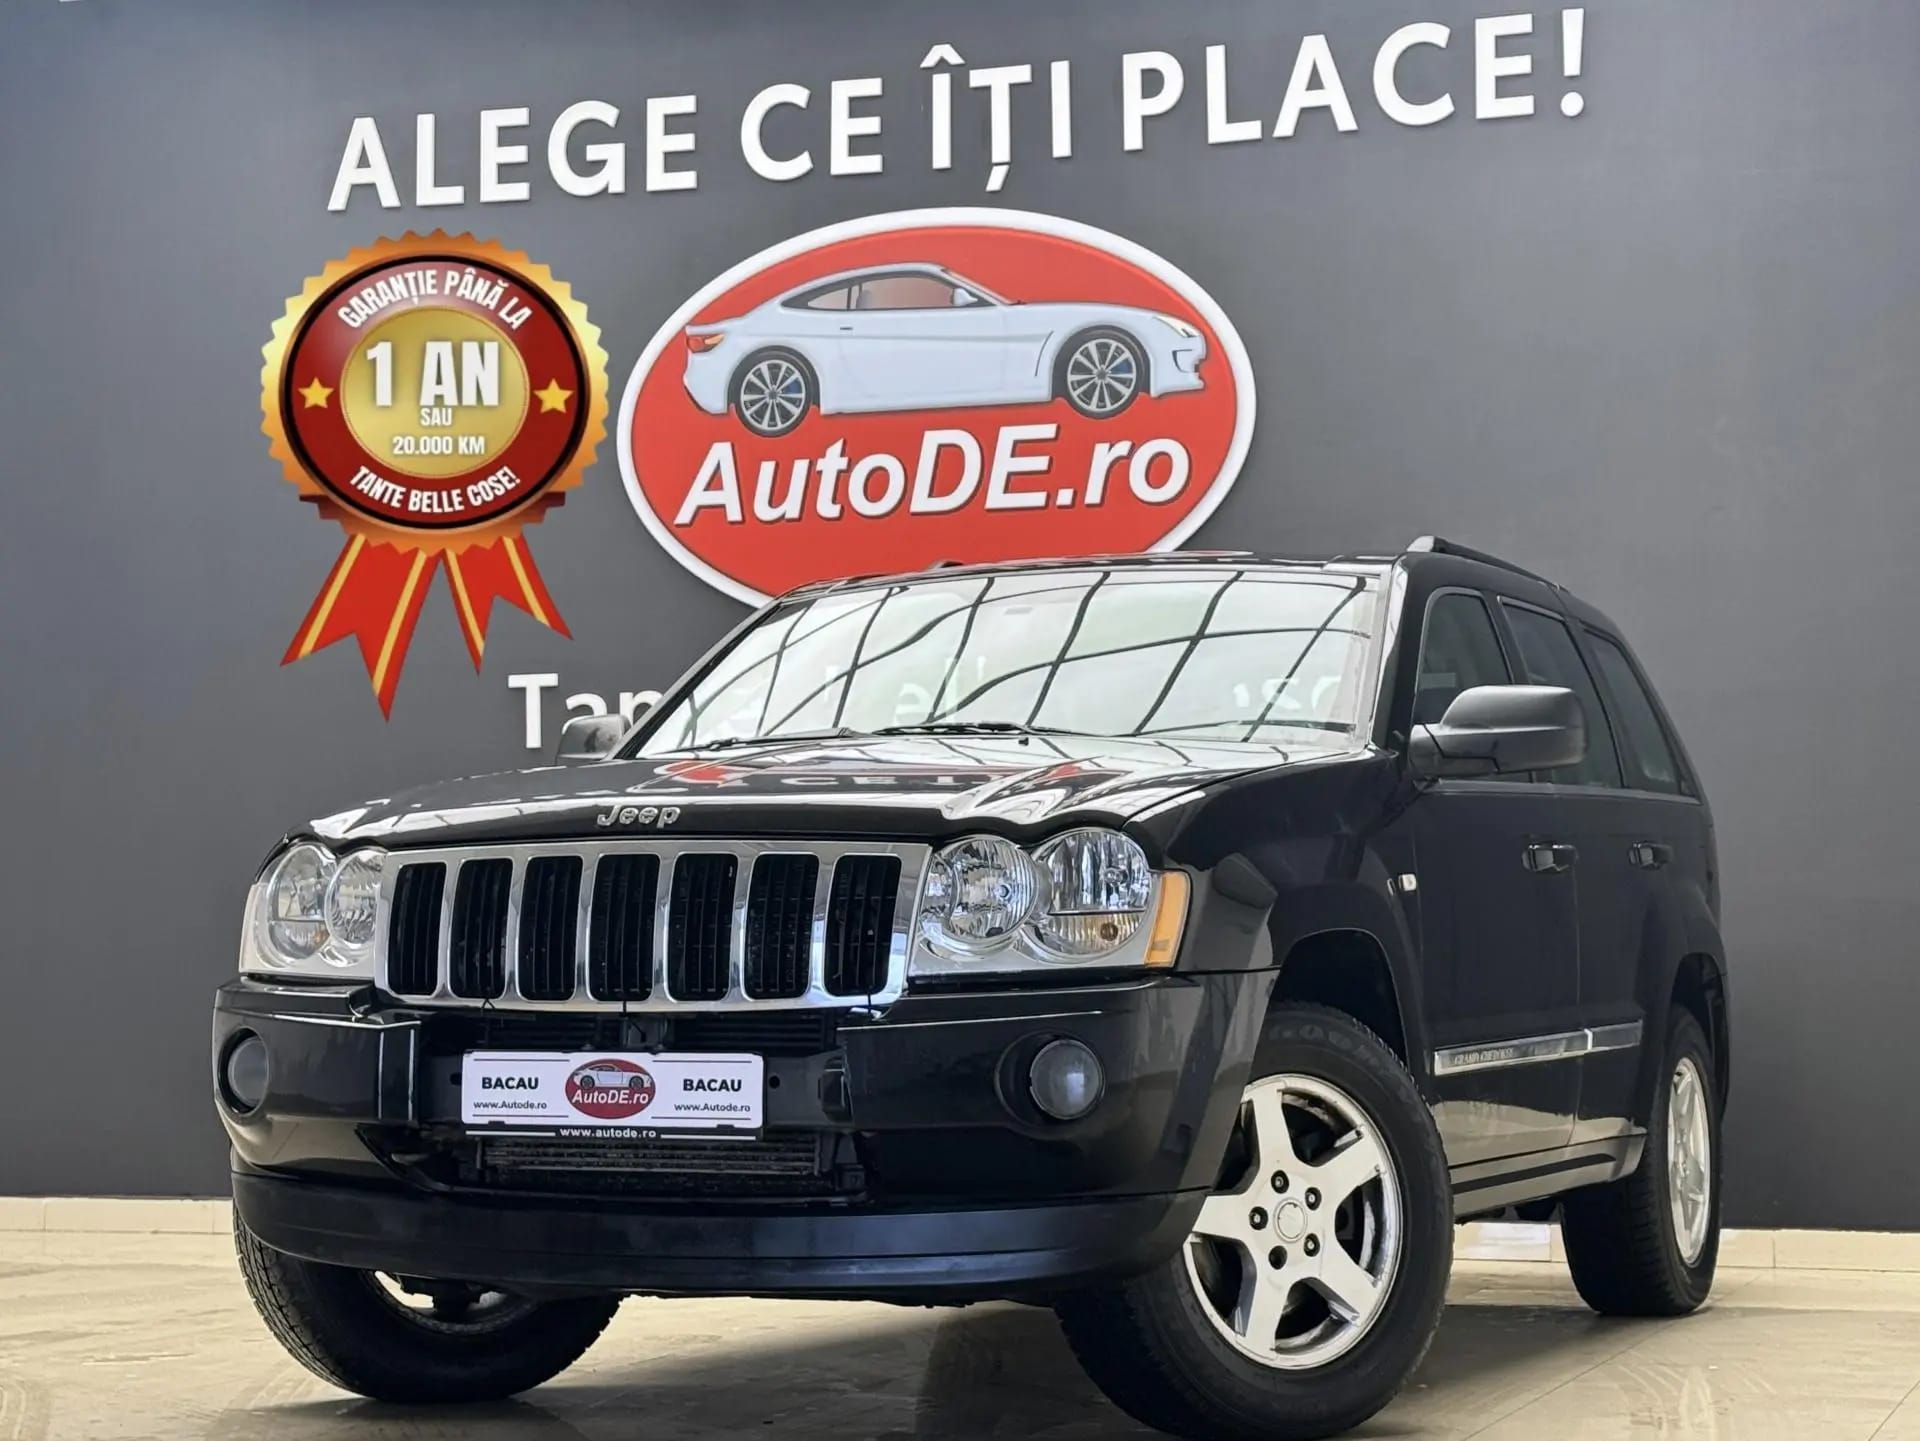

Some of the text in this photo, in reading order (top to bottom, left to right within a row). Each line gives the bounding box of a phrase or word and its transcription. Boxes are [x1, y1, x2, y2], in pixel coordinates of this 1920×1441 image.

[327, 7, 1585, 211] ALEGE CE ÎȚI PLACE!
[444, 267, 508, 310] PÂNĂ
[498, 296, 532, 330] LA
[367, 340, 500, 407] 1 AN
[420, 407, 452, 426] SAU
[393, 436, 485, 455] 20.000 KM
[674, 422, 1192, 528] AutoDE.ro
[350, 465, 521, 513] TANTE BELLE COSE!
[597, 805, 681, 829] Jeep
[481, 1076, 539, 1090] BACAU
[683, 1078, 742, 1092] BACAU
[473, 1100, 548, 1110] www.Autode.ro
[571, 1089, 650, 1106] AutoDE.ro
[674, 1102, 751, 1113] www.Autode.ro
[559, 1127, 657, 1139] www.autode.ro
